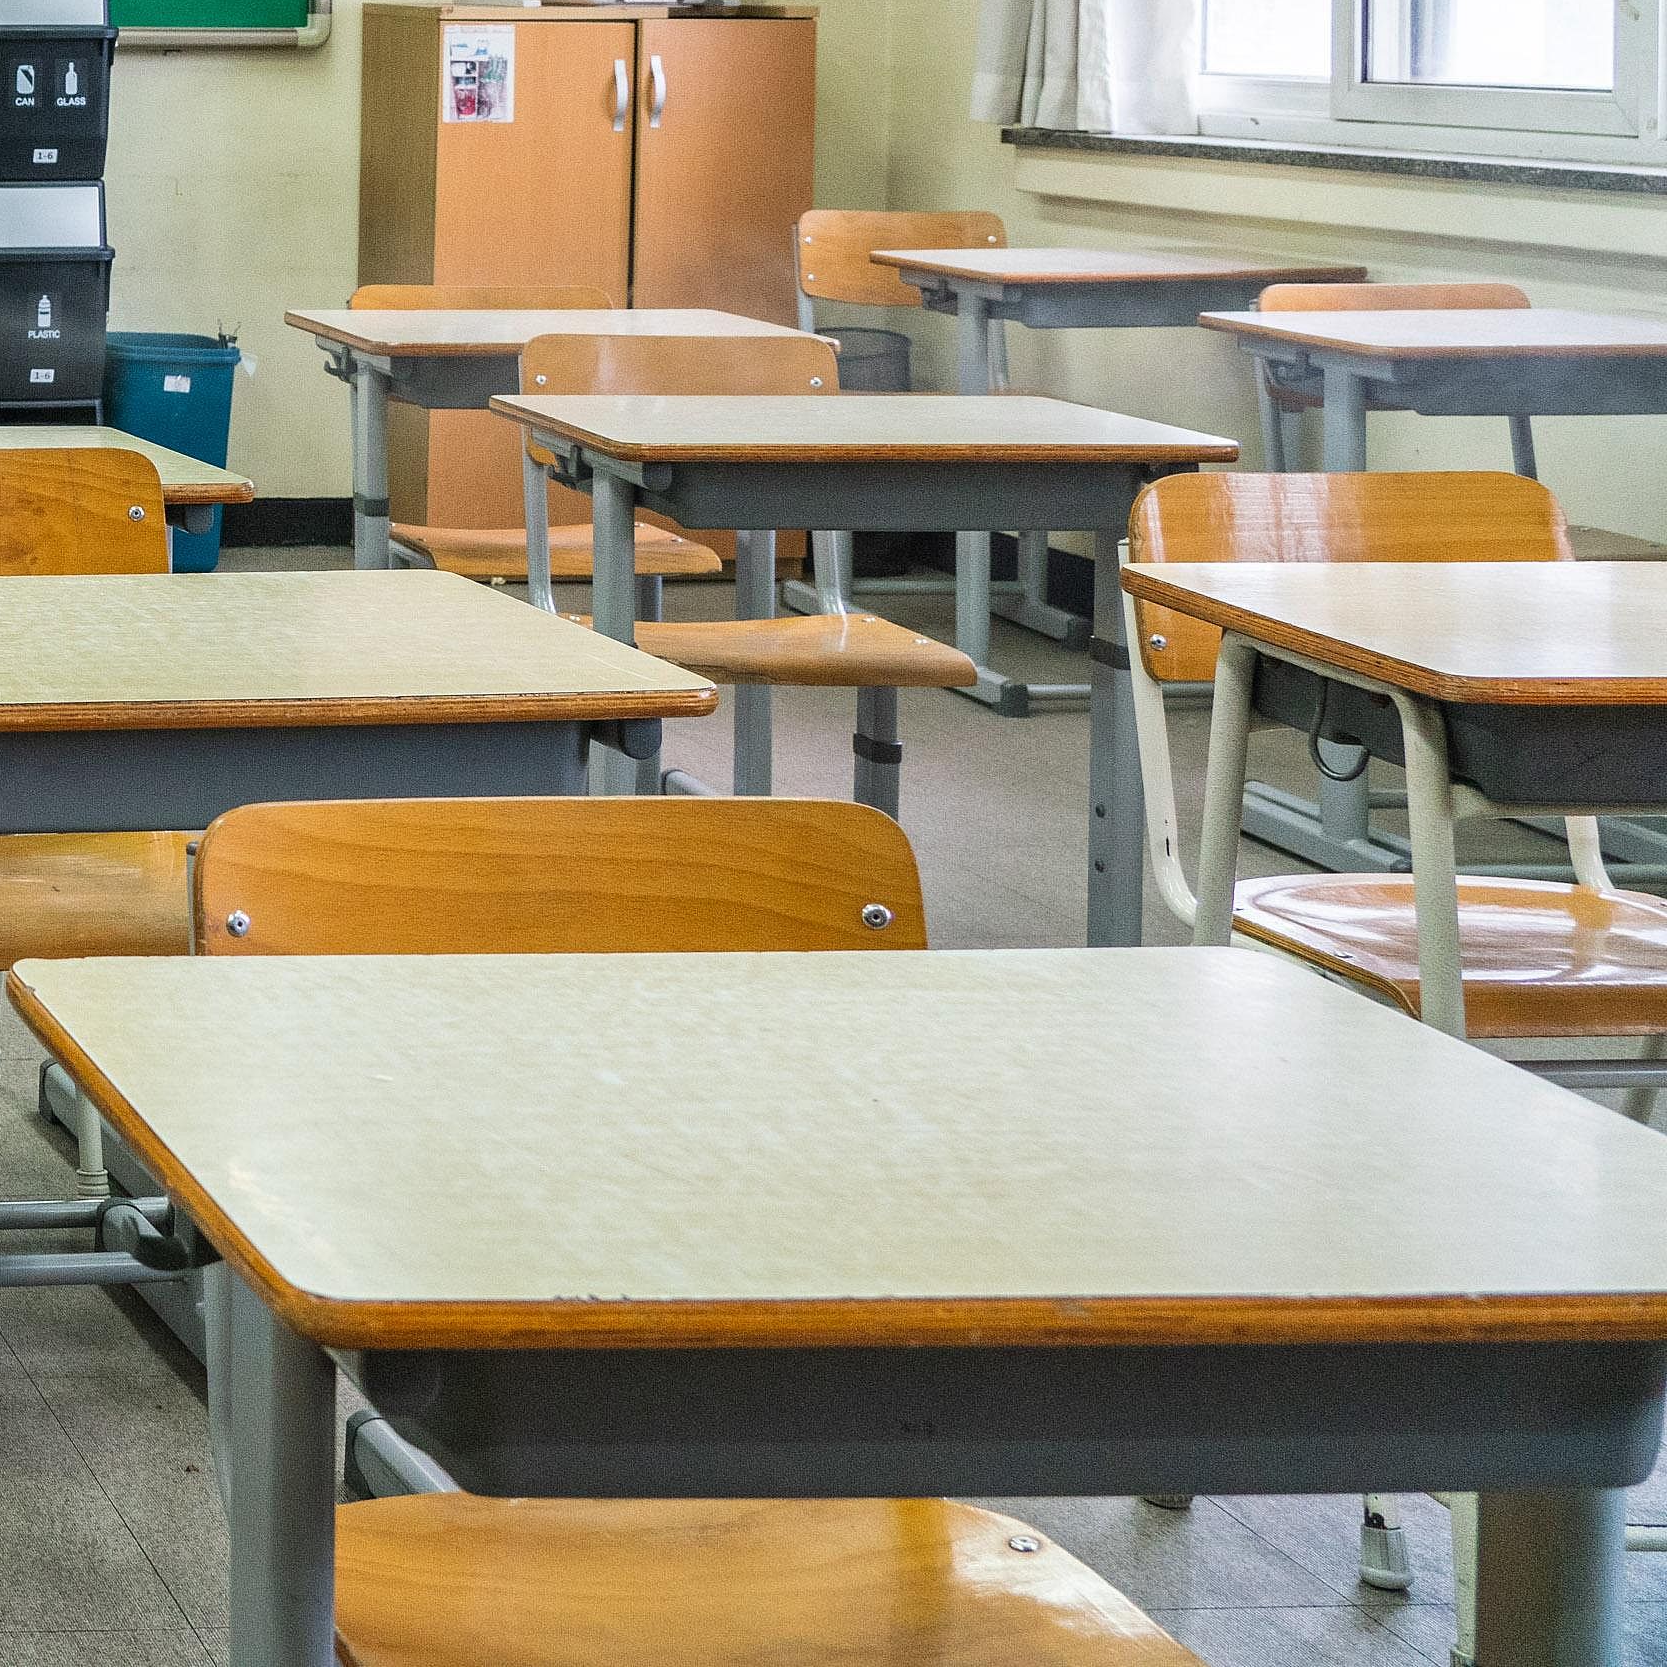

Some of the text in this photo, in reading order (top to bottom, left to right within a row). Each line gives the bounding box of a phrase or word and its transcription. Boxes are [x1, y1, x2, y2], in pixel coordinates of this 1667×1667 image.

[15, 97, 35, 106] CAN
[56, 97, 86, 106] GLASS
[37, 152, 53, 160] 1-6
[27, 330, 61, 339] PLASTIC
[35, 372, 51, 380] 1-6
